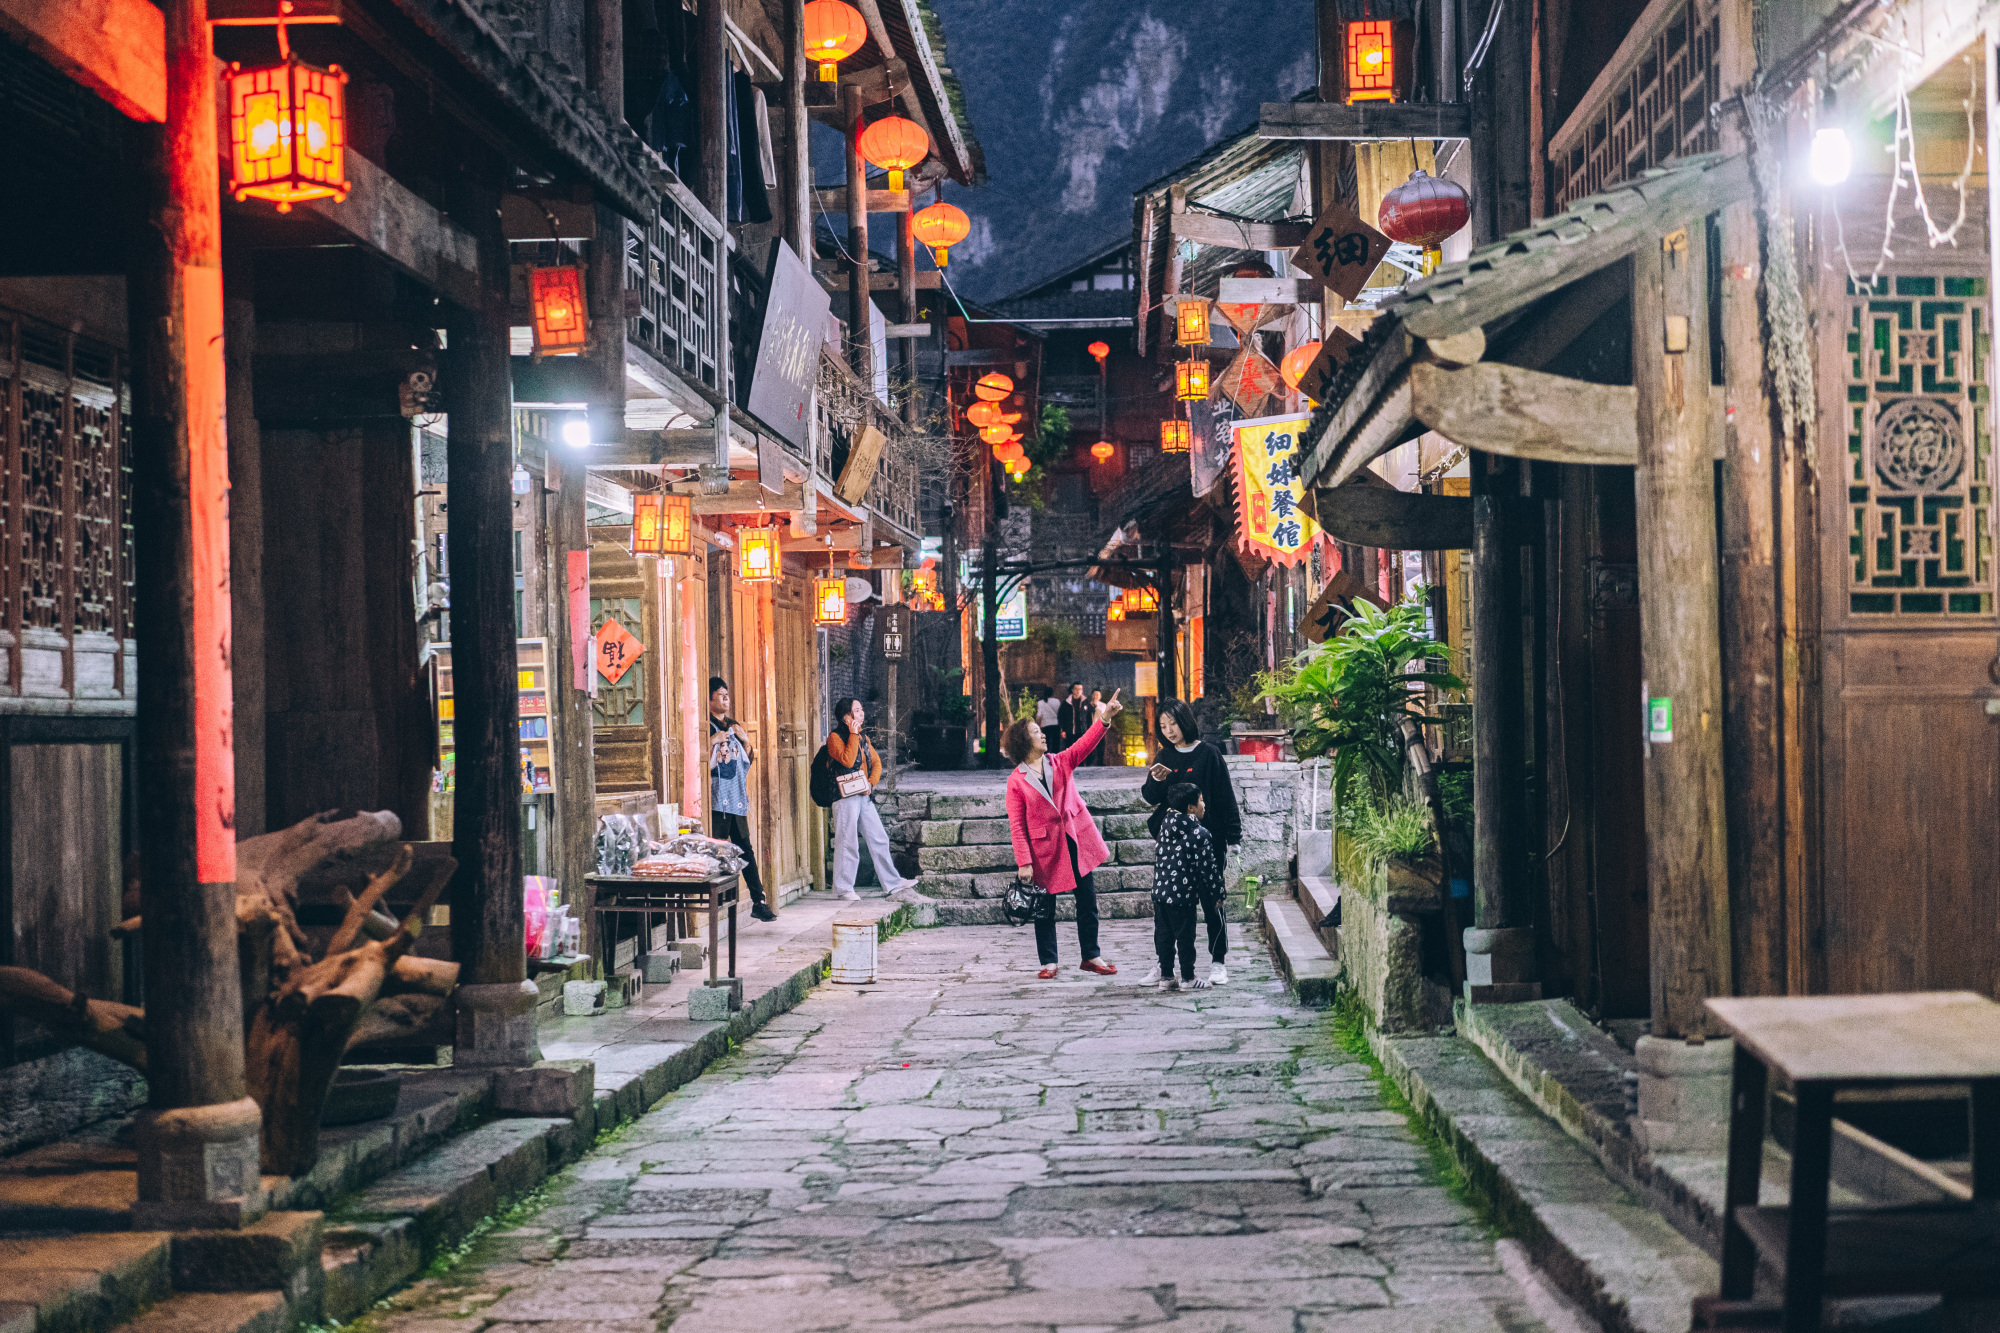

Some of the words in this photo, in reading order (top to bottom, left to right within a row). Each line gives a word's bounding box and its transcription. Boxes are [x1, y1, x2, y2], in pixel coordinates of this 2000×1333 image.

[1313, 227, 1369, 277] 细
[1265, 430, 1301, 548] 细妹餐馆
